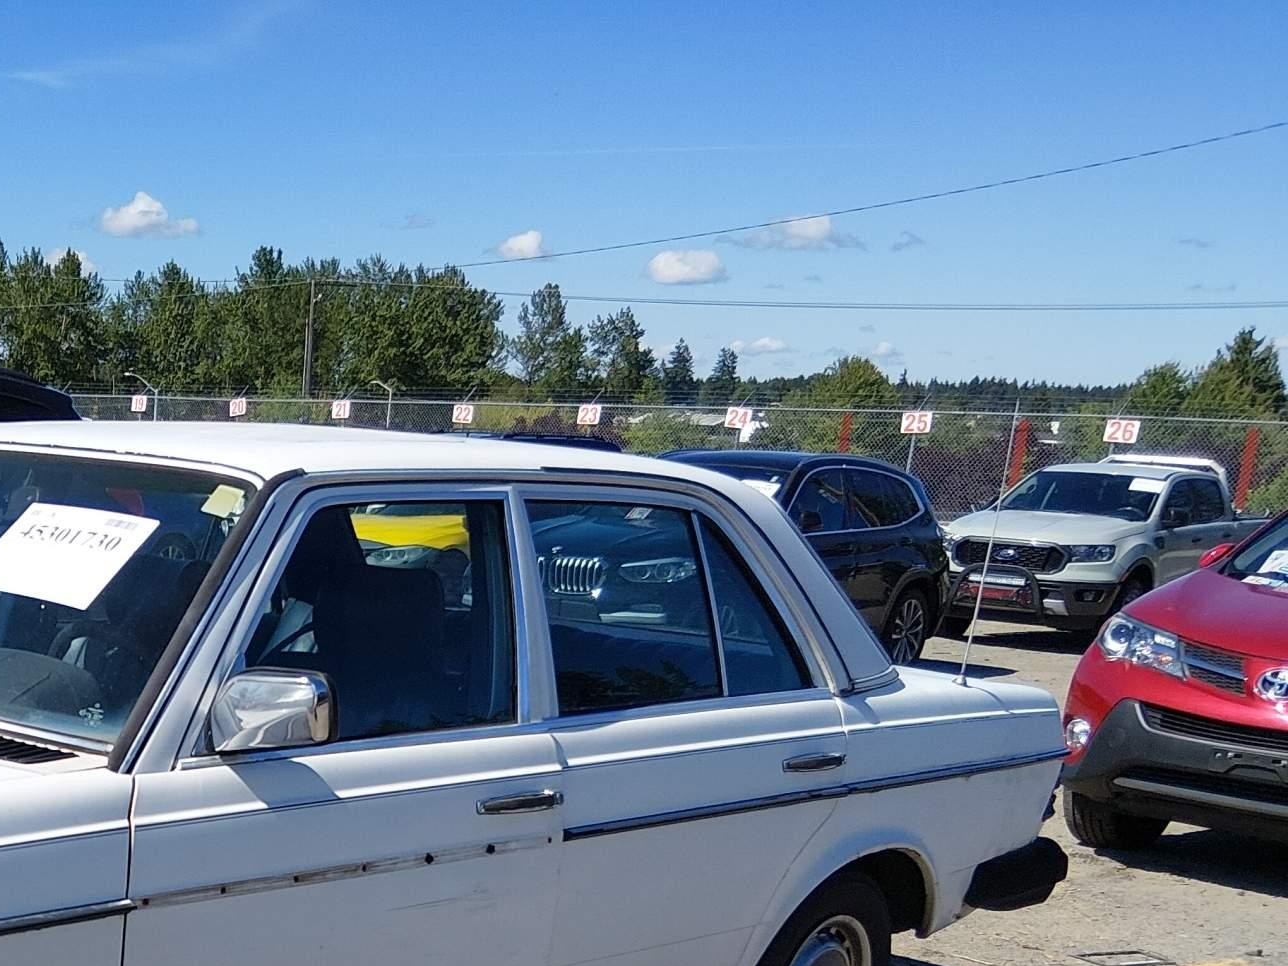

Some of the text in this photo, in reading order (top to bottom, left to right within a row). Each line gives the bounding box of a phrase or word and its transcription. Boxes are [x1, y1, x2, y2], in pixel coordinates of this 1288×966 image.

[134, 397, 144, 410] 19
[231, 400, 244, 415] 20
[335, 403, 346, 417] 21
[455, 407, 471, 421] 22
[579, 407, 598, 423] 23
[727, 409, 749, 428] 24
[905, 414, 928, 432] 25
[1108, 421, 1135, 440] 26
[20, 524, 122, 551] 45301730
